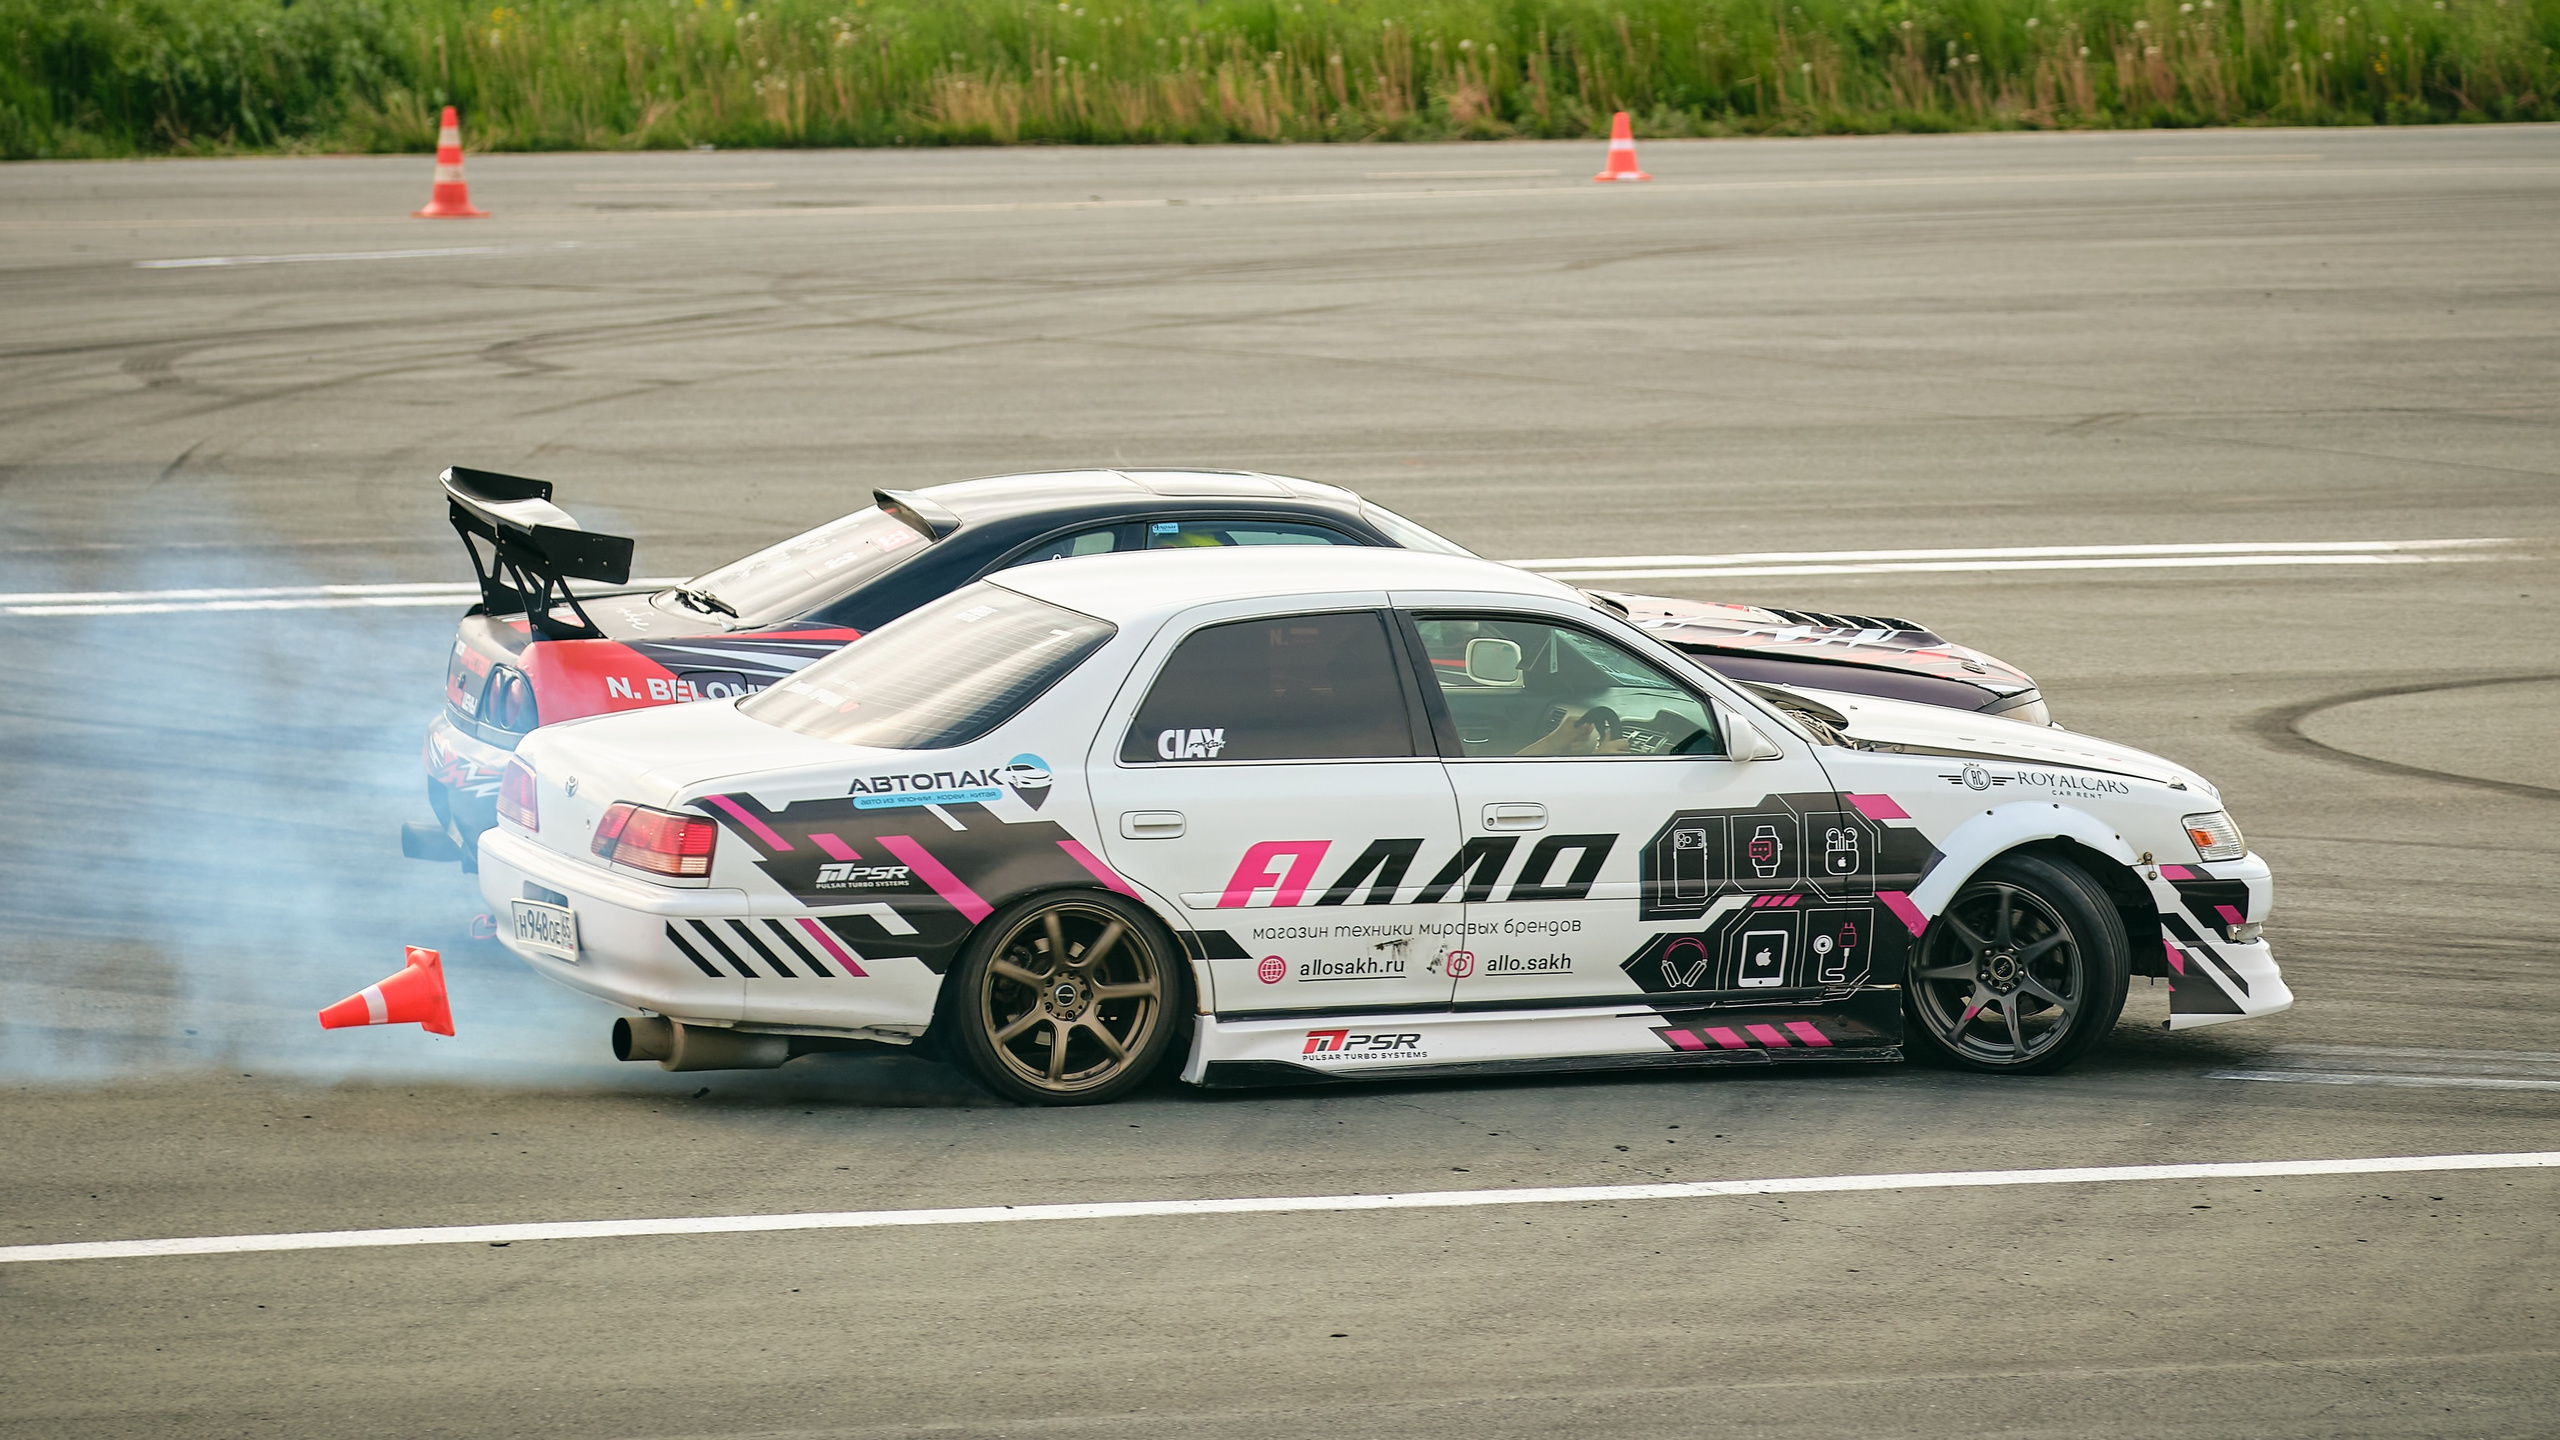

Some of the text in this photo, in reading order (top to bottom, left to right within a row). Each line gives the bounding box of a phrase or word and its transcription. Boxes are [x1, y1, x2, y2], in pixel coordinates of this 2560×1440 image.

[605, 676, 642, 699] N.
[848, 768, 1005, 795] АВТОПАК
[2051, 789, 2103, 800] CAR RENT
[815, 880, 910, 890] PULSAR TURBO SYSTEMS
[1252, 918, 1583, 941] магазин техники мировых брендов
[1300, 956, 1405, 976] allosakh.ru
[1486, 953, 1572, 972] allo.sakh
[1301, 1050, 1428, 1062] PULSAR TURBO SYSTEMS
